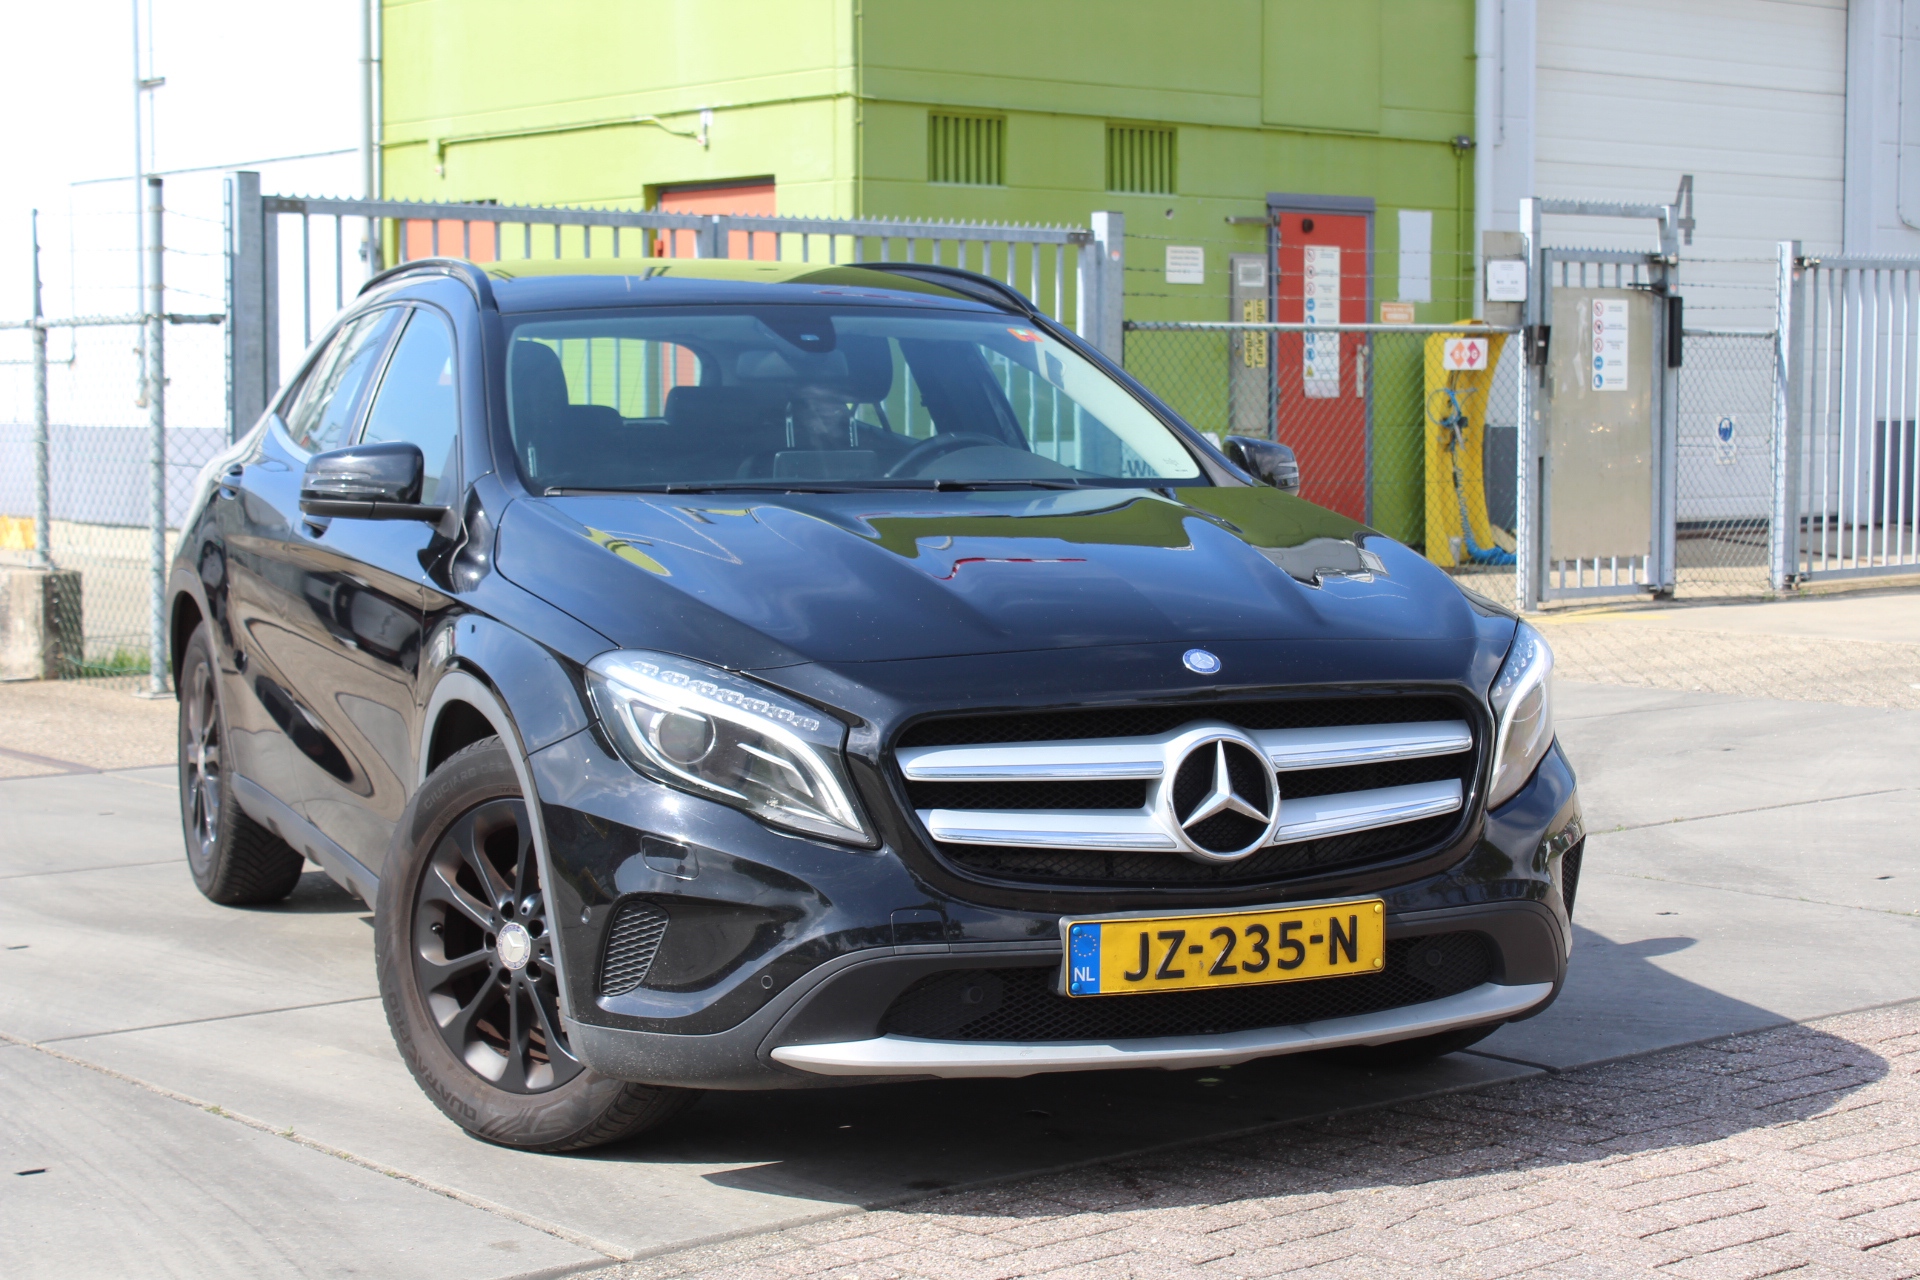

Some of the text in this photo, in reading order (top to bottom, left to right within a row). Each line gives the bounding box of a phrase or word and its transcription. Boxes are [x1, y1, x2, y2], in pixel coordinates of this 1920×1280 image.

[1674, 175, 1695, 245] 4
[1255, 299, 1265, 366] Tankwgen
[1073, 967, 1095, 982] NL
[1124, 915, 1358, 981] JZ-235-N
